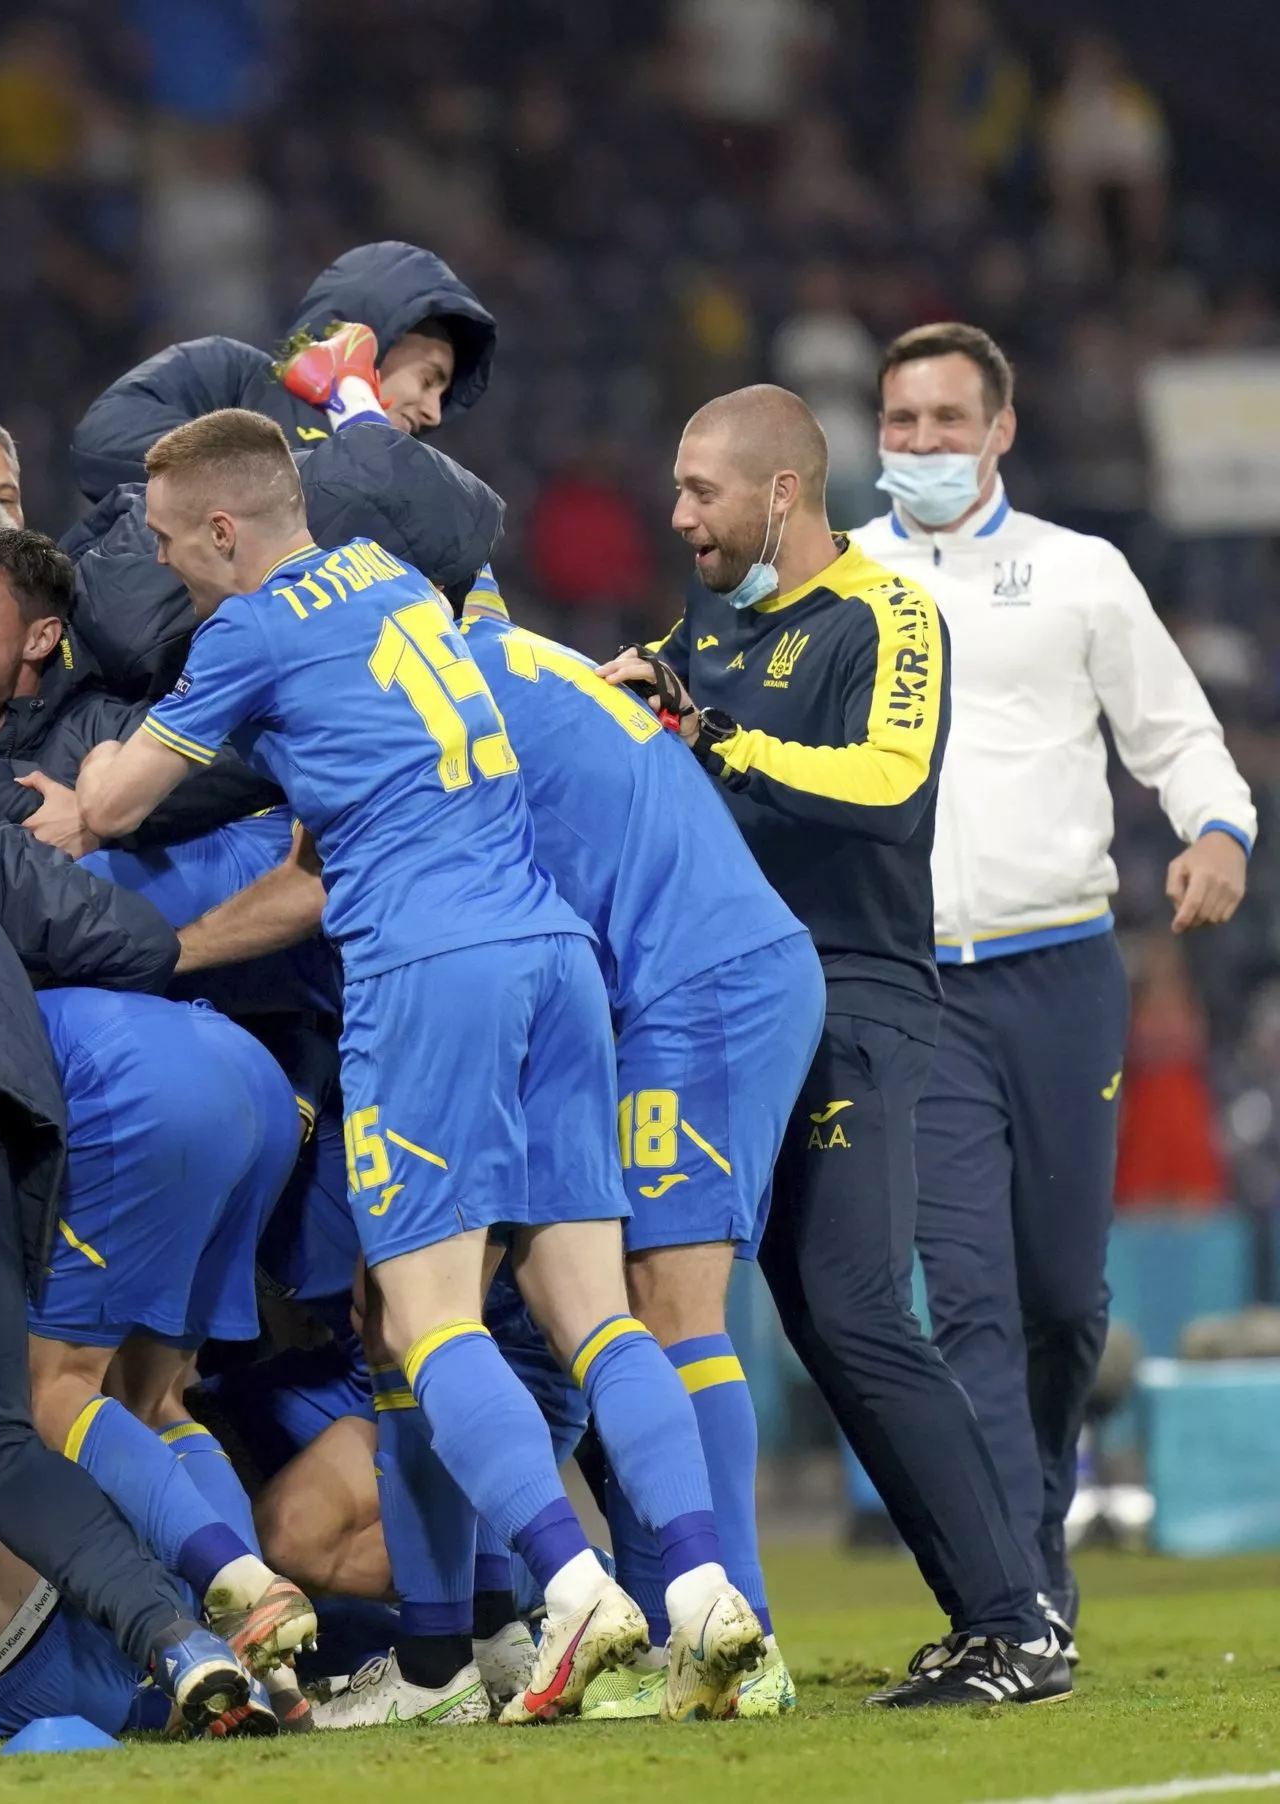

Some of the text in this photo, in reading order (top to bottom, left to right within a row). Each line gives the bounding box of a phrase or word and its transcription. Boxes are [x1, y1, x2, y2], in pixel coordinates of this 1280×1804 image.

[498, 626, 662, 744] 1
[763, 680, 789, 689] UKRAINE
[619, 1088, 679, 1168] 18
[808, 1124, 851, 1149] A.A.
[7, 1625, 27, 1649] Klein
[367, 1600, 519, 1792] 15
